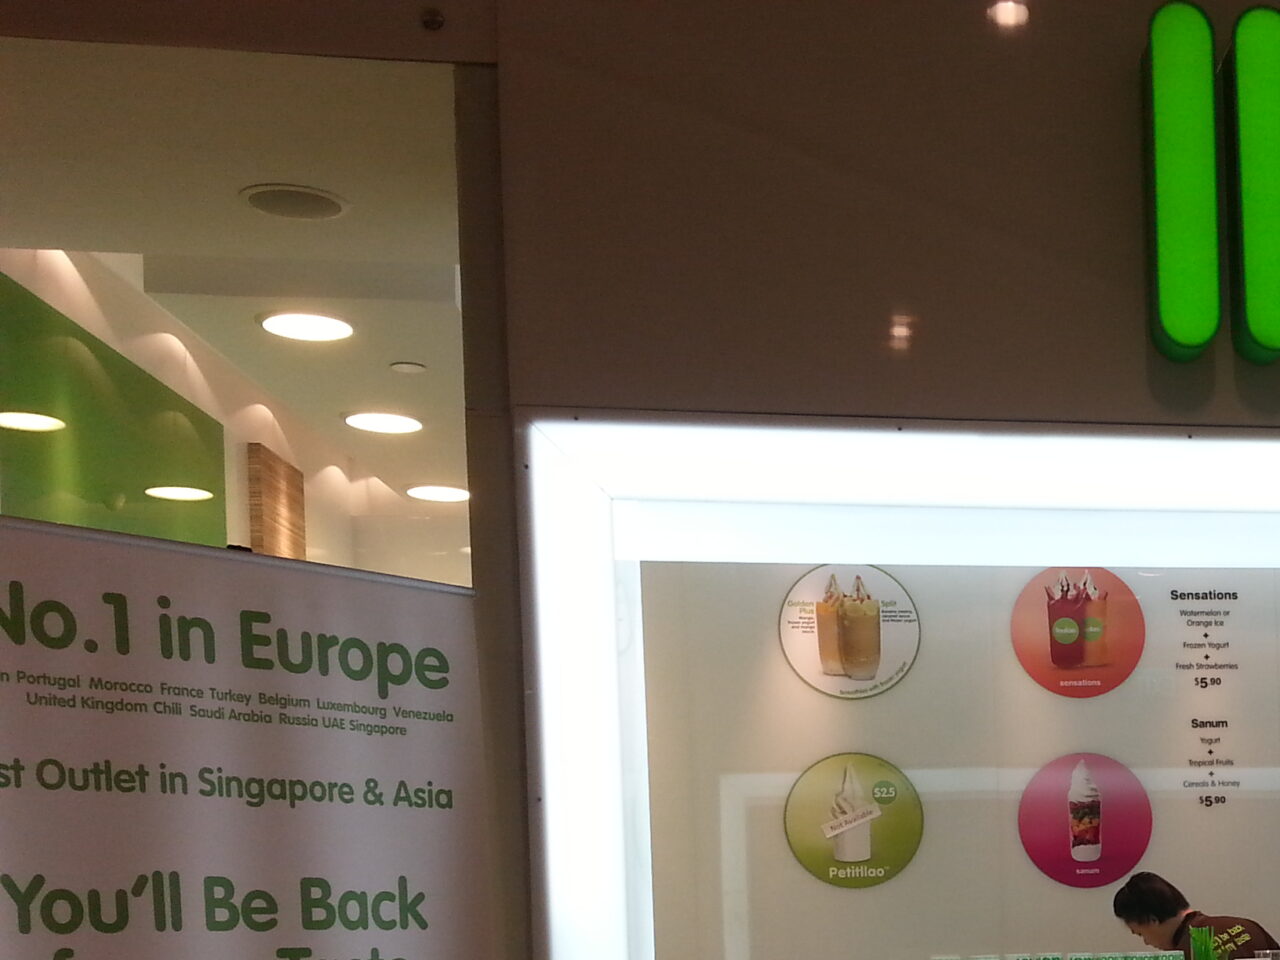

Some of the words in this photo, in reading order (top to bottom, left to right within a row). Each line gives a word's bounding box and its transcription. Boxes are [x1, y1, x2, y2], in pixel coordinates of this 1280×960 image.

[1170, 589, 1238, 600] Sensations
[1179, 609, 1221, 617] Watermelon
[1186, 619, 1213, 628] Orange
[1213, 618, 1224, 627] Ice
[157, 595, 216, 664] in
[240, 609, 450, 700] Europe
[1183, 641, 1206, 649] Frozen
[1207, 641, 1230, 651] Yogurt
[1175, 662, 1195, 670] Fresh
[1196, 662, 1239, 670] Strawberries
[1060, 679, 1101, 687] sensations
[1194, 677, 1222, 689] $5.90
[17, 670, 80, 690] Portugal
[89, 676, 153, 695] Morocco
[160, 683, 204, 699] France
[209, 687, 251, 707] Turkey
[258, 692, 311, 710] Belgium
[317, 698, 387, 720] Luxembourg
[393, 706, 454, 723] Venezuela
[26, 691, 76, 709] United
[81, 696, 148, 714] Kingdom
[153, 701, 182, 716] Chili
[190, 704, 225, 721] Saudi
[228, 708, 272, 724] Arabia
[279, 712, 318, 727] Russia
[323, 717, 346, 731] UAE
[349, 719, 407, 737] Singapore
[1191, 718, 1228, 729] Sanum
[1200, 736, 1221, 745] Yogurt
[1188, 759, 1215, 768] Tropical
[1215, 758, 1234, 767] Fruits
[36, 759, 149, 795] Outlet
[160, 763, 188, 796] in
[198, 767, 354, 809] Singapore
[363, 777, 385, 807] &
[393, 780, 454, 810] Asia
[1183, 779, 1210, 788] Cereals
[1218, 780, 1241, 789] Honey
[1198, 795, 1227, 808] $5.90
[828, 865, 885, 879] Petitllao
[0, 870, 183, 936] You'll
[204, 876, 279, 934] Be
[300, 876, 429, 932] Back
